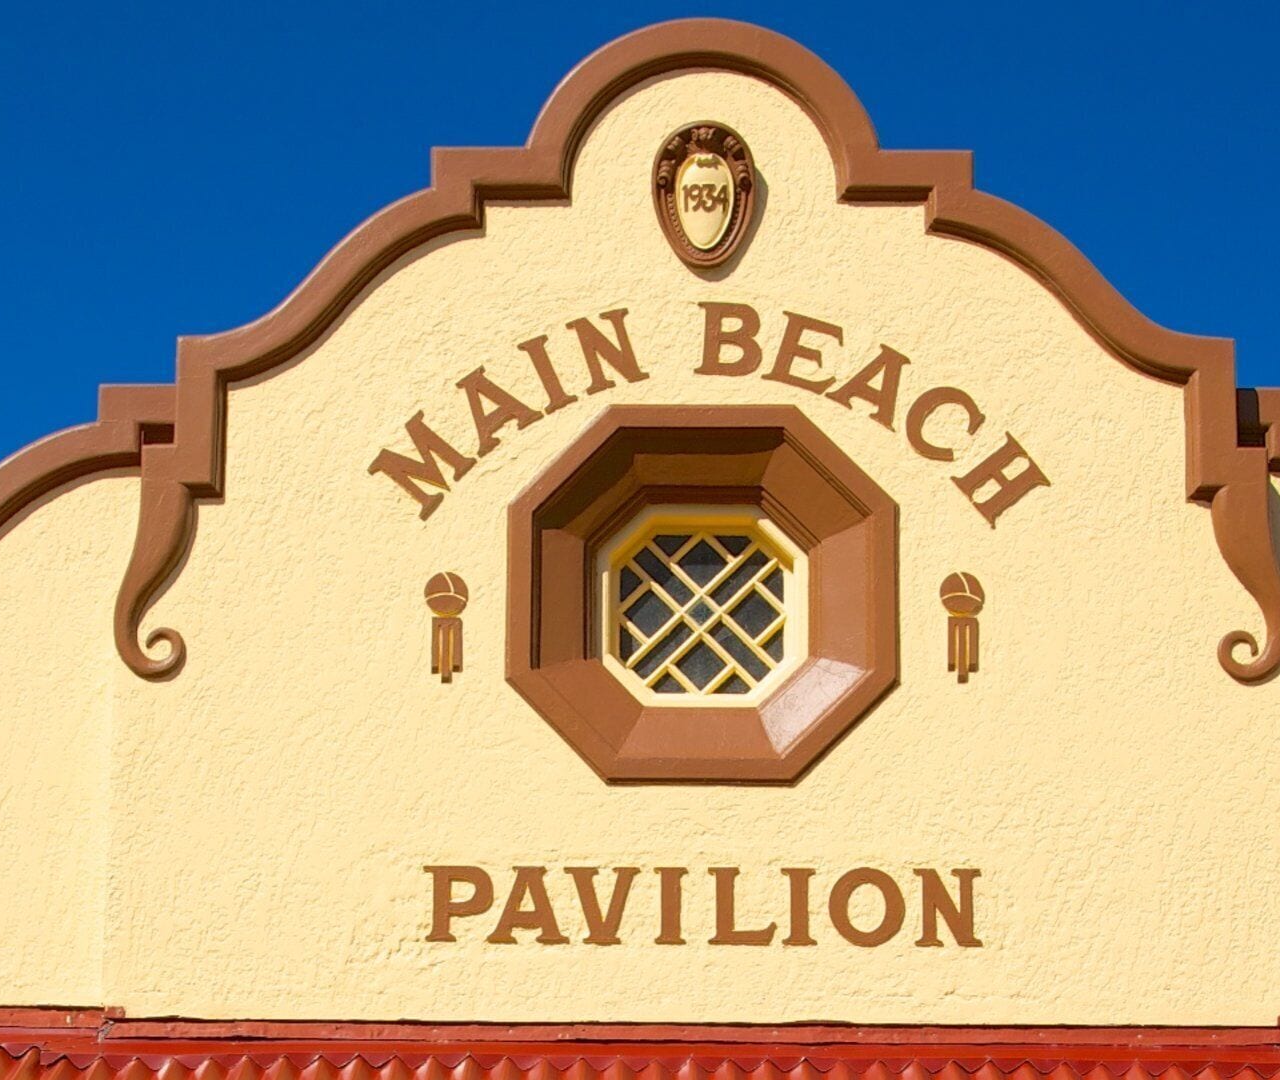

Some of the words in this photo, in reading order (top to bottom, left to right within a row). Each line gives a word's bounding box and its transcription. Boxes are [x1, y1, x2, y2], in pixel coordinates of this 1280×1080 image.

[682, 184, 729, 213] 1934
[367, 307, 650, 522] MAIN
[694, 301, 1051, 530] BEACH
[423, 865, 983, 948] PAVILION
